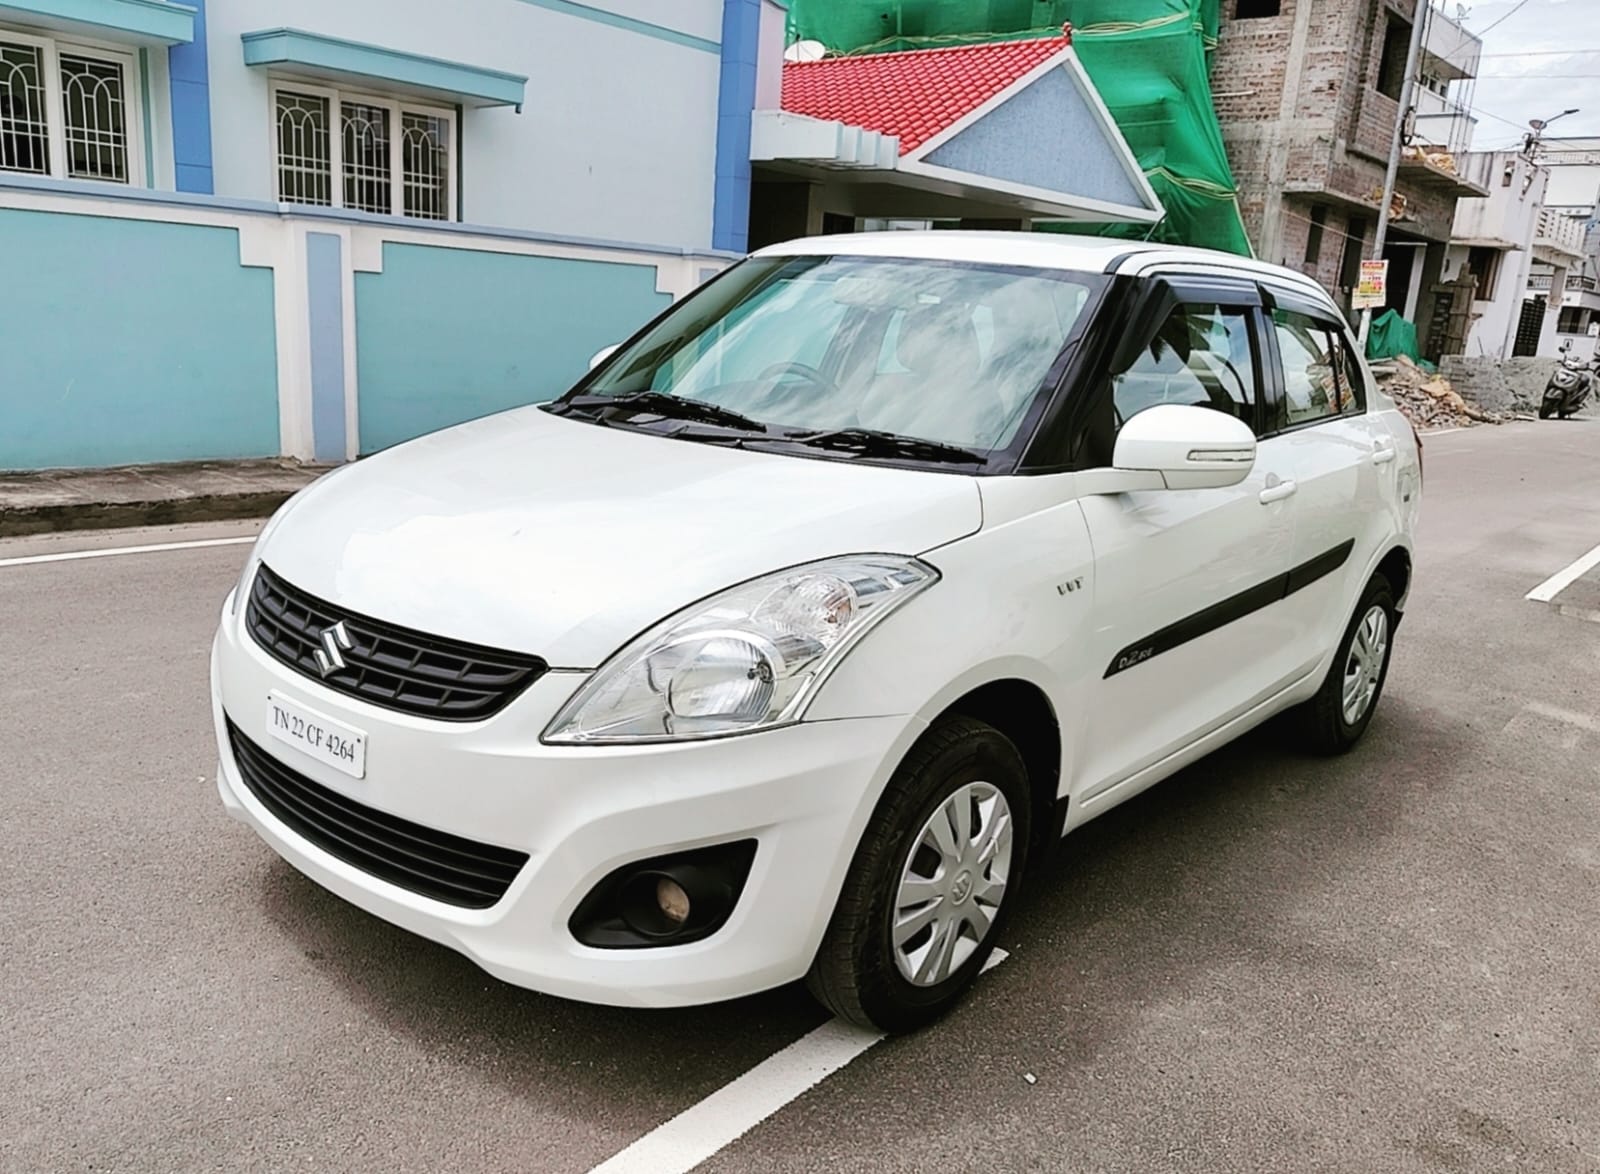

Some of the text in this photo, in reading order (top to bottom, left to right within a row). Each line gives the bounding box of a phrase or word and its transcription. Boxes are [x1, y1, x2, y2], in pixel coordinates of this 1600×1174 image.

[273, 705, 354, 763] TN 22 CF 4264
